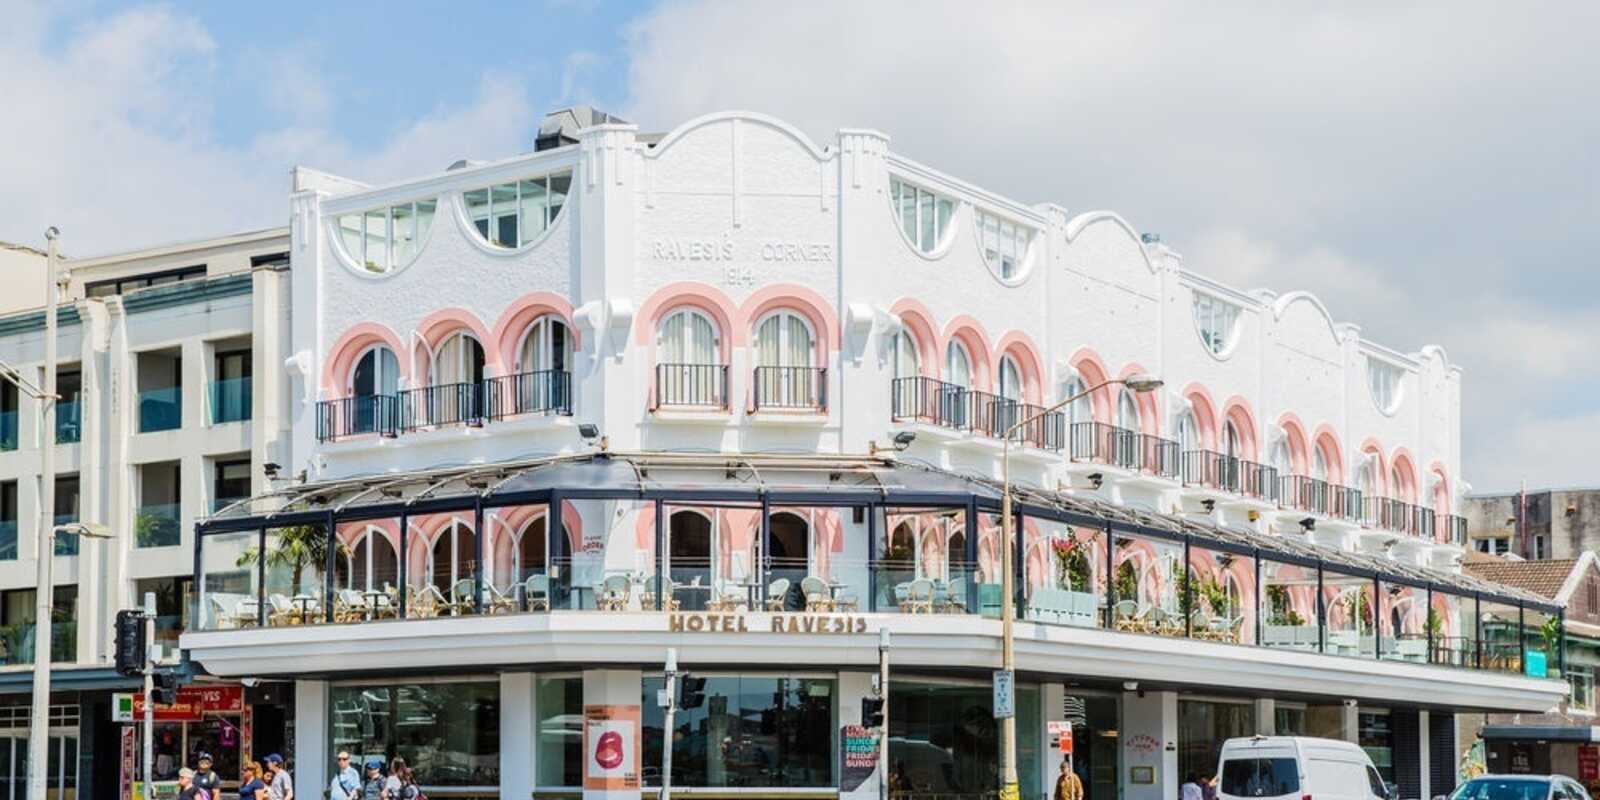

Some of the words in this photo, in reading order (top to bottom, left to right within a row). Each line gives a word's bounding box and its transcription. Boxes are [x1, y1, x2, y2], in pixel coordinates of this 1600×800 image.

[652, 241, 733, 261] RAVESIS
[761, 243, 832, 262] CORNER
[722, 266, 754, 285] 1914
[669, 615, 748, 632] HOTEL
[771, 616, 867, 633] RAVESIS
